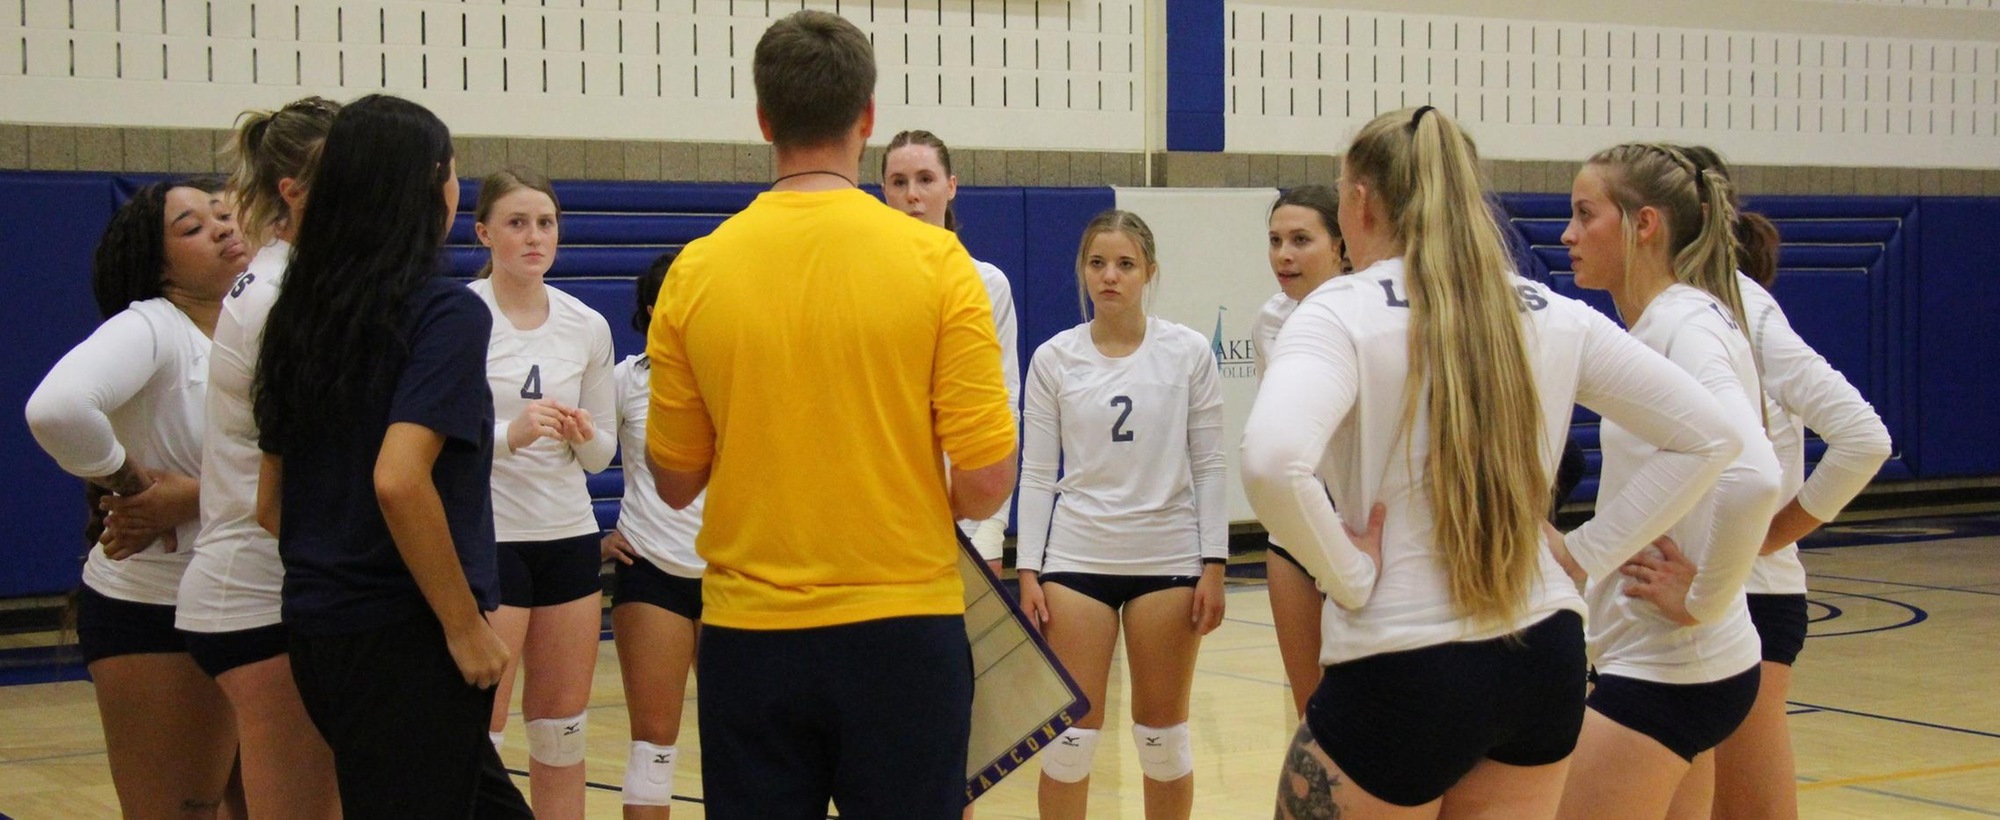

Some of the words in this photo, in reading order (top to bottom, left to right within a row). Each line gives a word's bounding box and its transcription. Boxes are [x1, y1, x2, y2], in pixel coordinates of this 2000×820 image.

[520, 364, 543, 400] 4
[1222, 366, 1256, 378] OLLE
[1110, 395, 1134, 442] 2
[965, 710, 1073, 801] FALCONS
